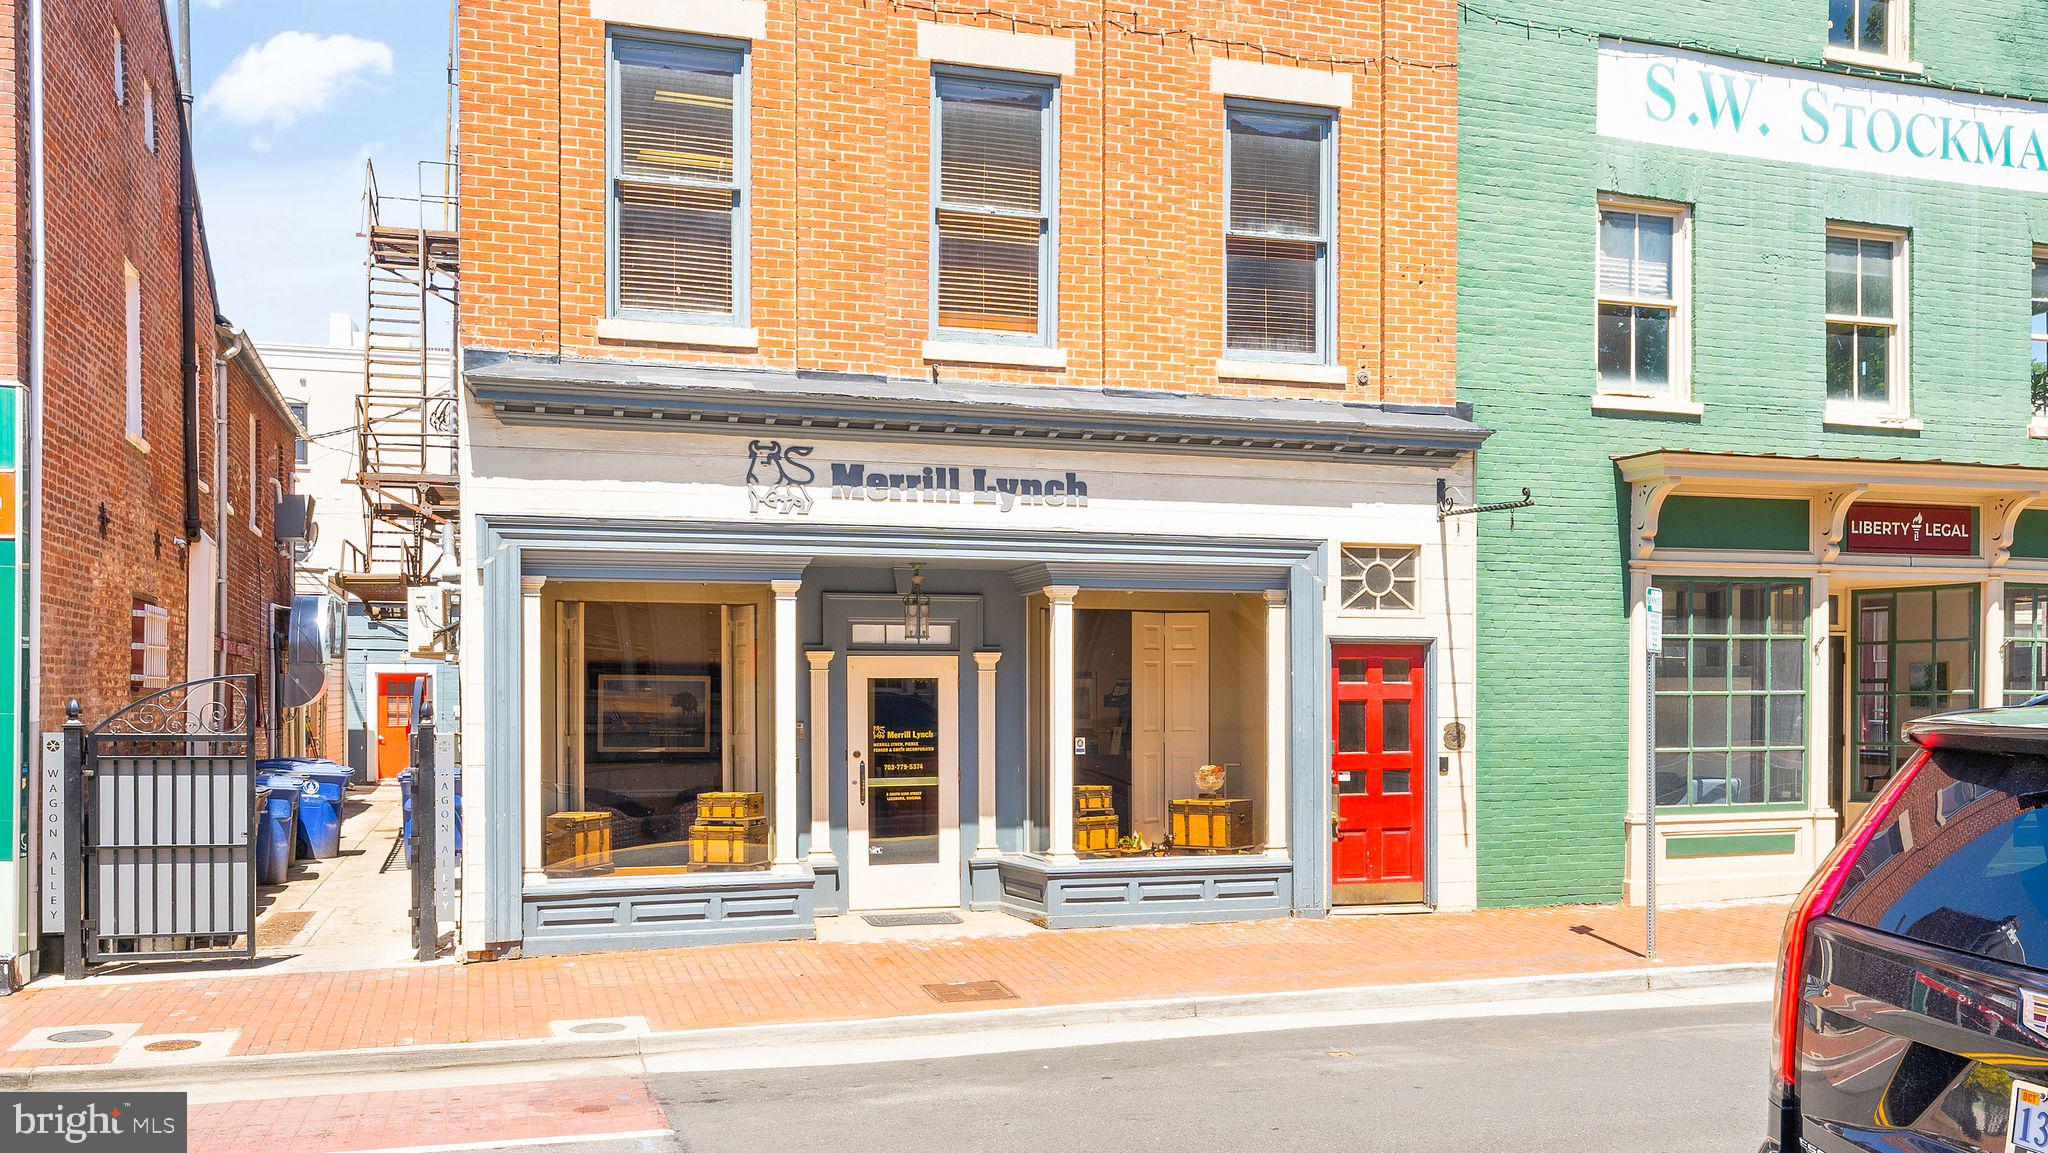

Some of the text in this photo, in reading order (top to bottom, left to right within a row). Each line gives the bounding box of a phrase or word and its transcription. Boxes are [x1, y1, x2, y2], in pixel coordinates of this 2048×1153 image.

[1645, 62, 1770, 137] S.W.
[831, 463, 1088, 513] Merrill Lynch
[1851, 520, 1969, 538] LIBERTY LEGAL
[887, 730, 934, 740] Merrill Lynch
[47, 769, 59, 919] WAGON ALLEY
[2022, 1092, 2037, 1104] OCT
